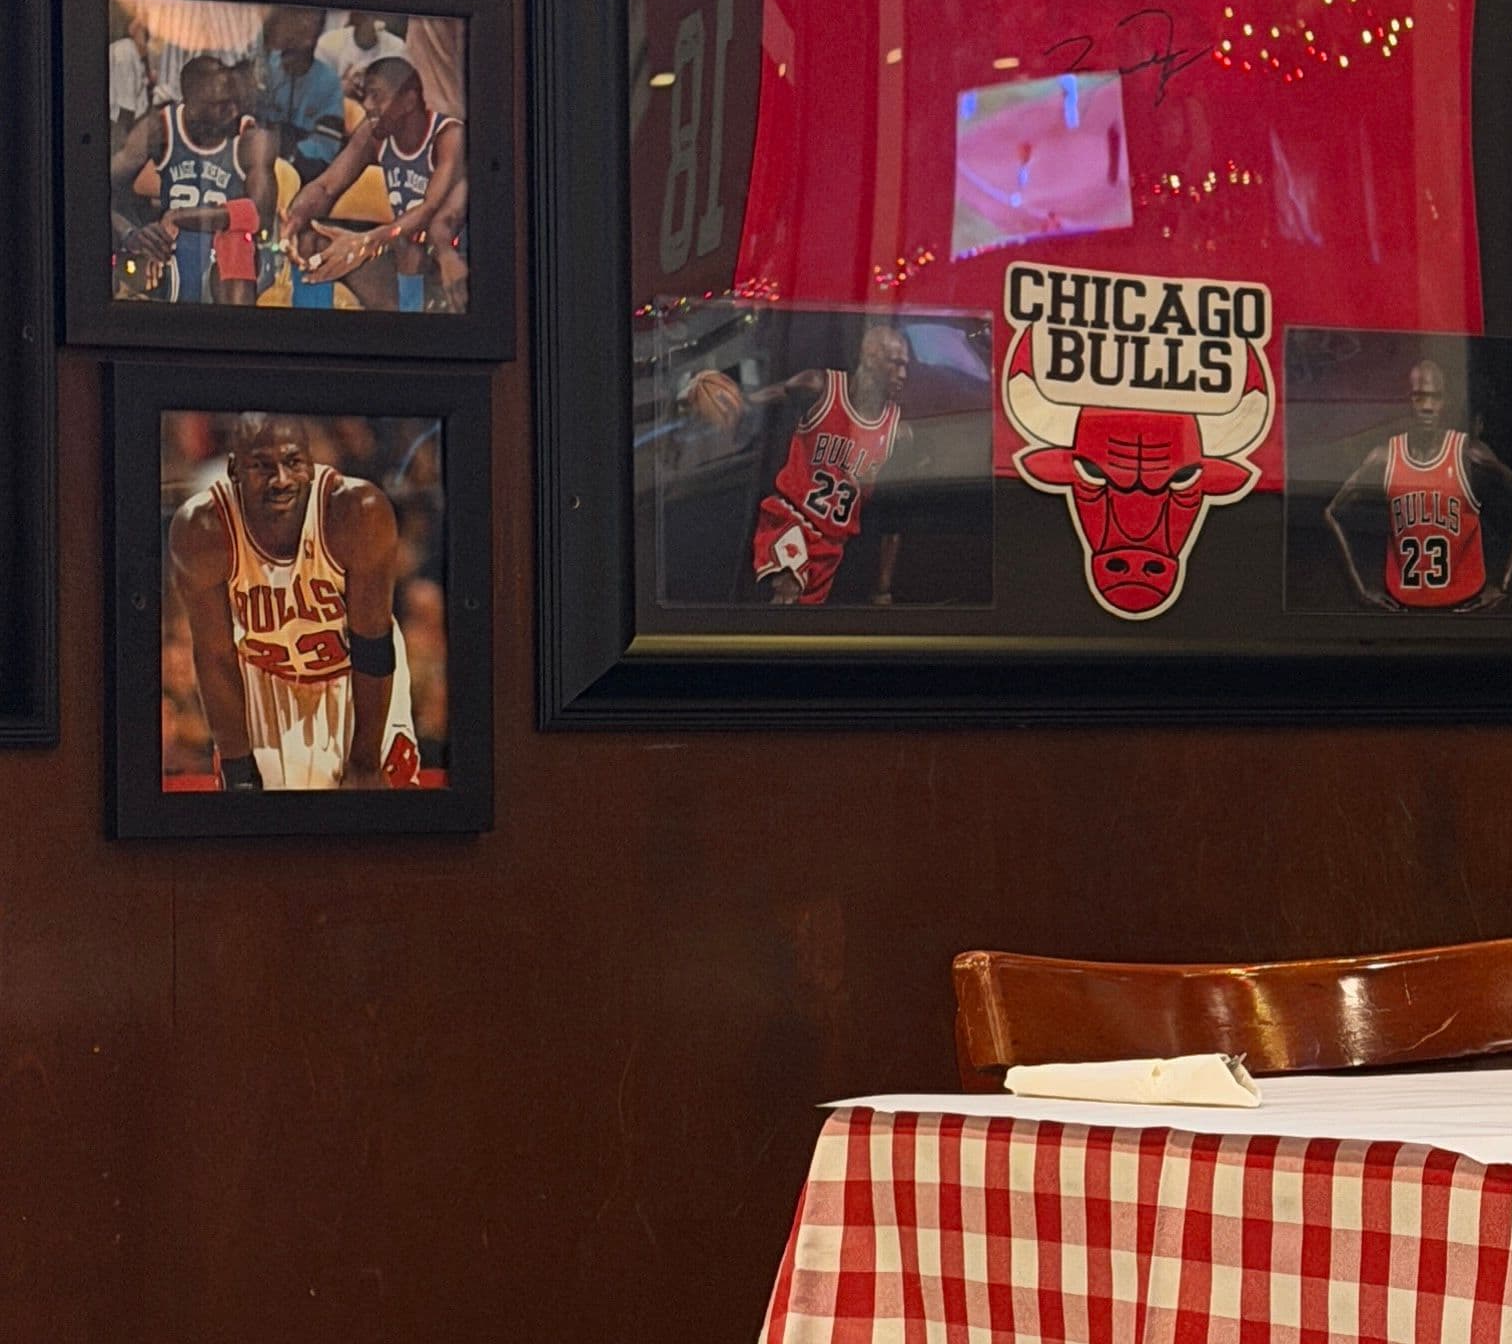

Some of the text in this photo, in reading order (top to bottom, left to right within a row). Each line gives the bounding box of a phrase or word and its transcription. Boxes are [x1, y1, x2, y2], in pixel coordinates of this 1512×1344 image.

[1008, 267, 1268, 340] CHICAGO
[1044, 330, 1234, 395] BULLS
[803, 470, 861, 526] 23
[1400, 535, 1451, 589] 23
